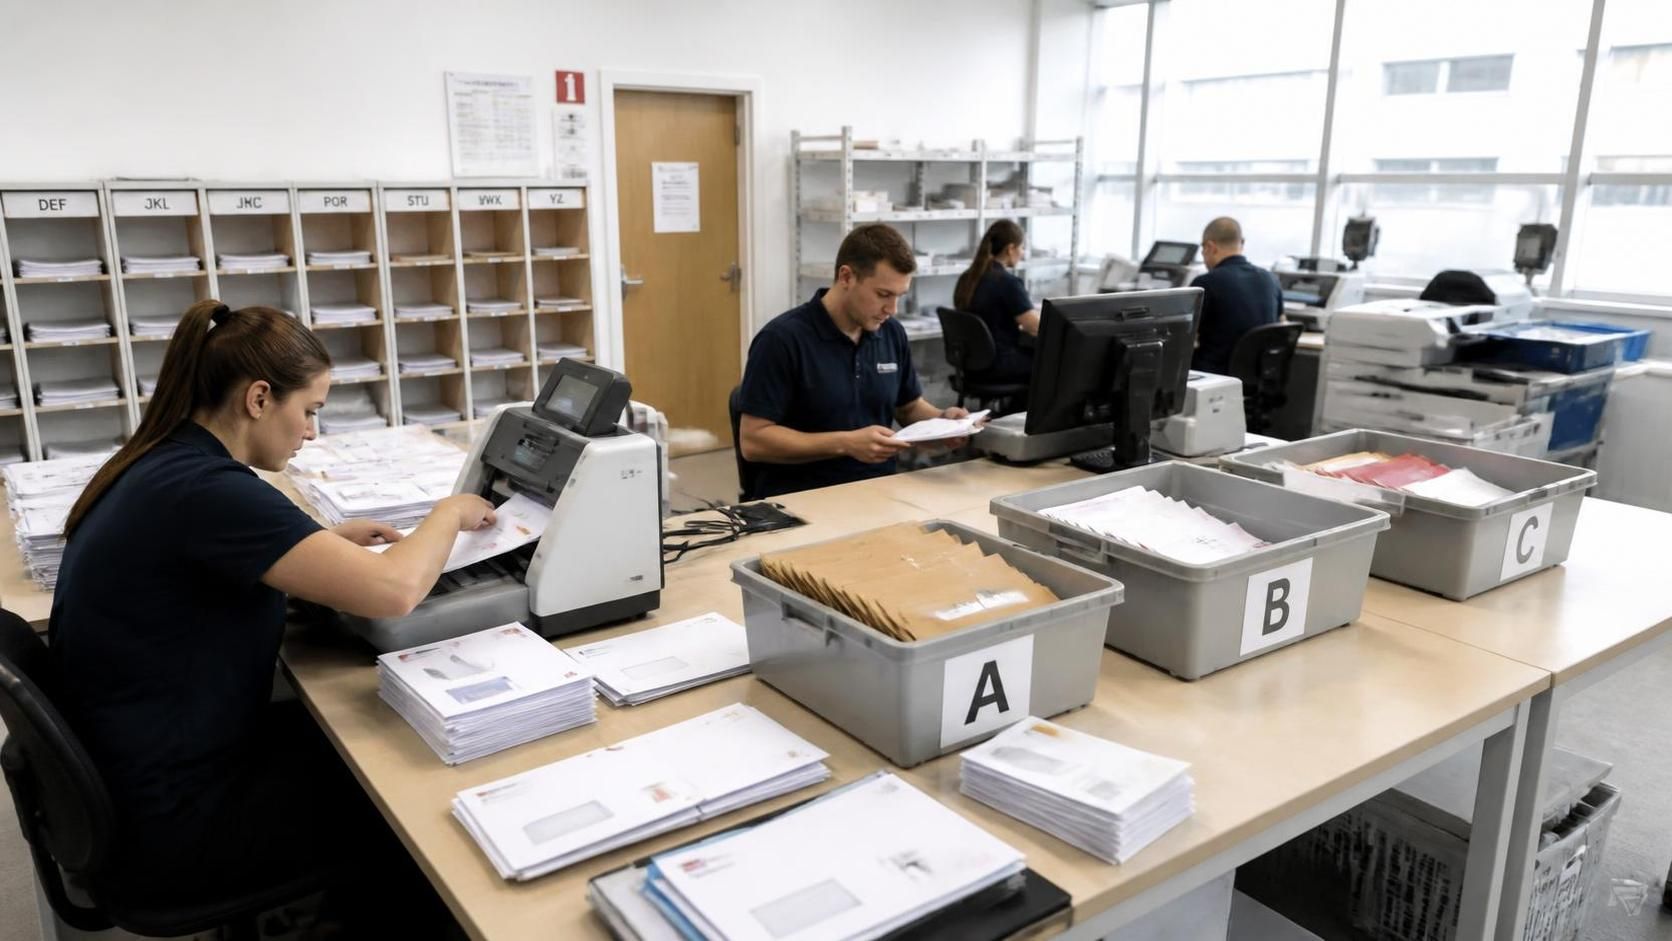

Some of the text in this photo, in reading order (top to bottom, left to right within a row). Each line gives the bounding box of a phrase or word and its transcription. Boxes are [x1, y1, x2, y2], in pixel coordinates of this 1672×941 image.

[38, 199, 67, 211] DEF
[144, 198, 169, 210] JKL
[407, 195, 429, 206] STU
[1515, 515, 1539, 565] C
[1261, 577, 1291, 636] B
[963, 659, 1010, 726] A
